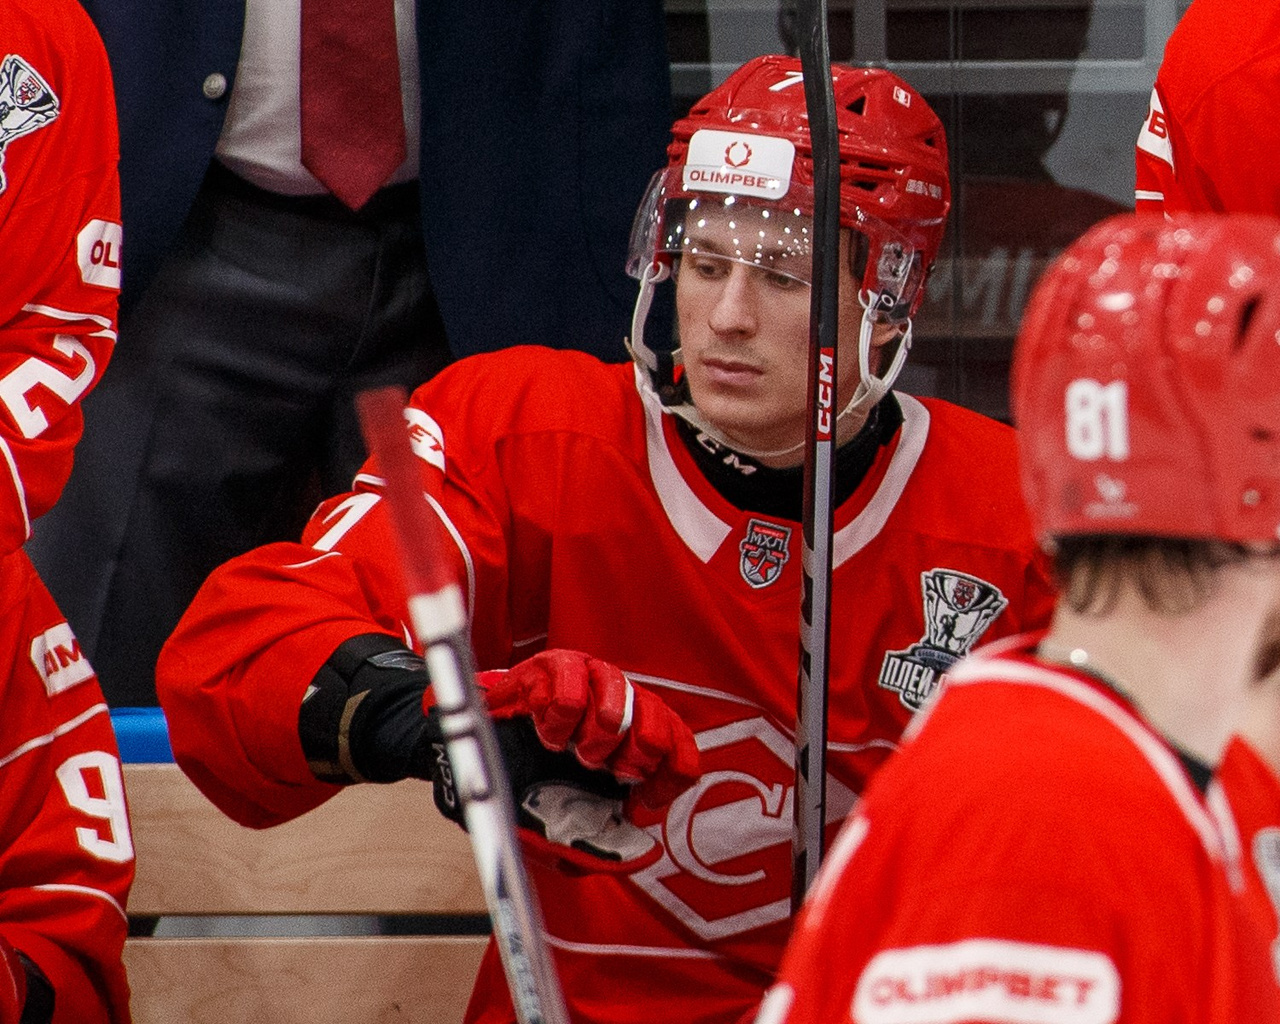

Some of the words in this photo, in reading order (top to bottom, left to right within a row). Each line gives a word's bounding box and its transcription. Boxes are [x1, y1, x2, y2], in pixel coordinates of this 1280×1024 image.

[0, 332, 97, 441] 2
[816, 354, 834, 434] CCM
[1065, 377, 1131, 464] 81
[749, 531, 784, 551] МХЛ
[55, 750, 136, 864] 9
[869, 968, 1096, 1008] OLIMPBET
